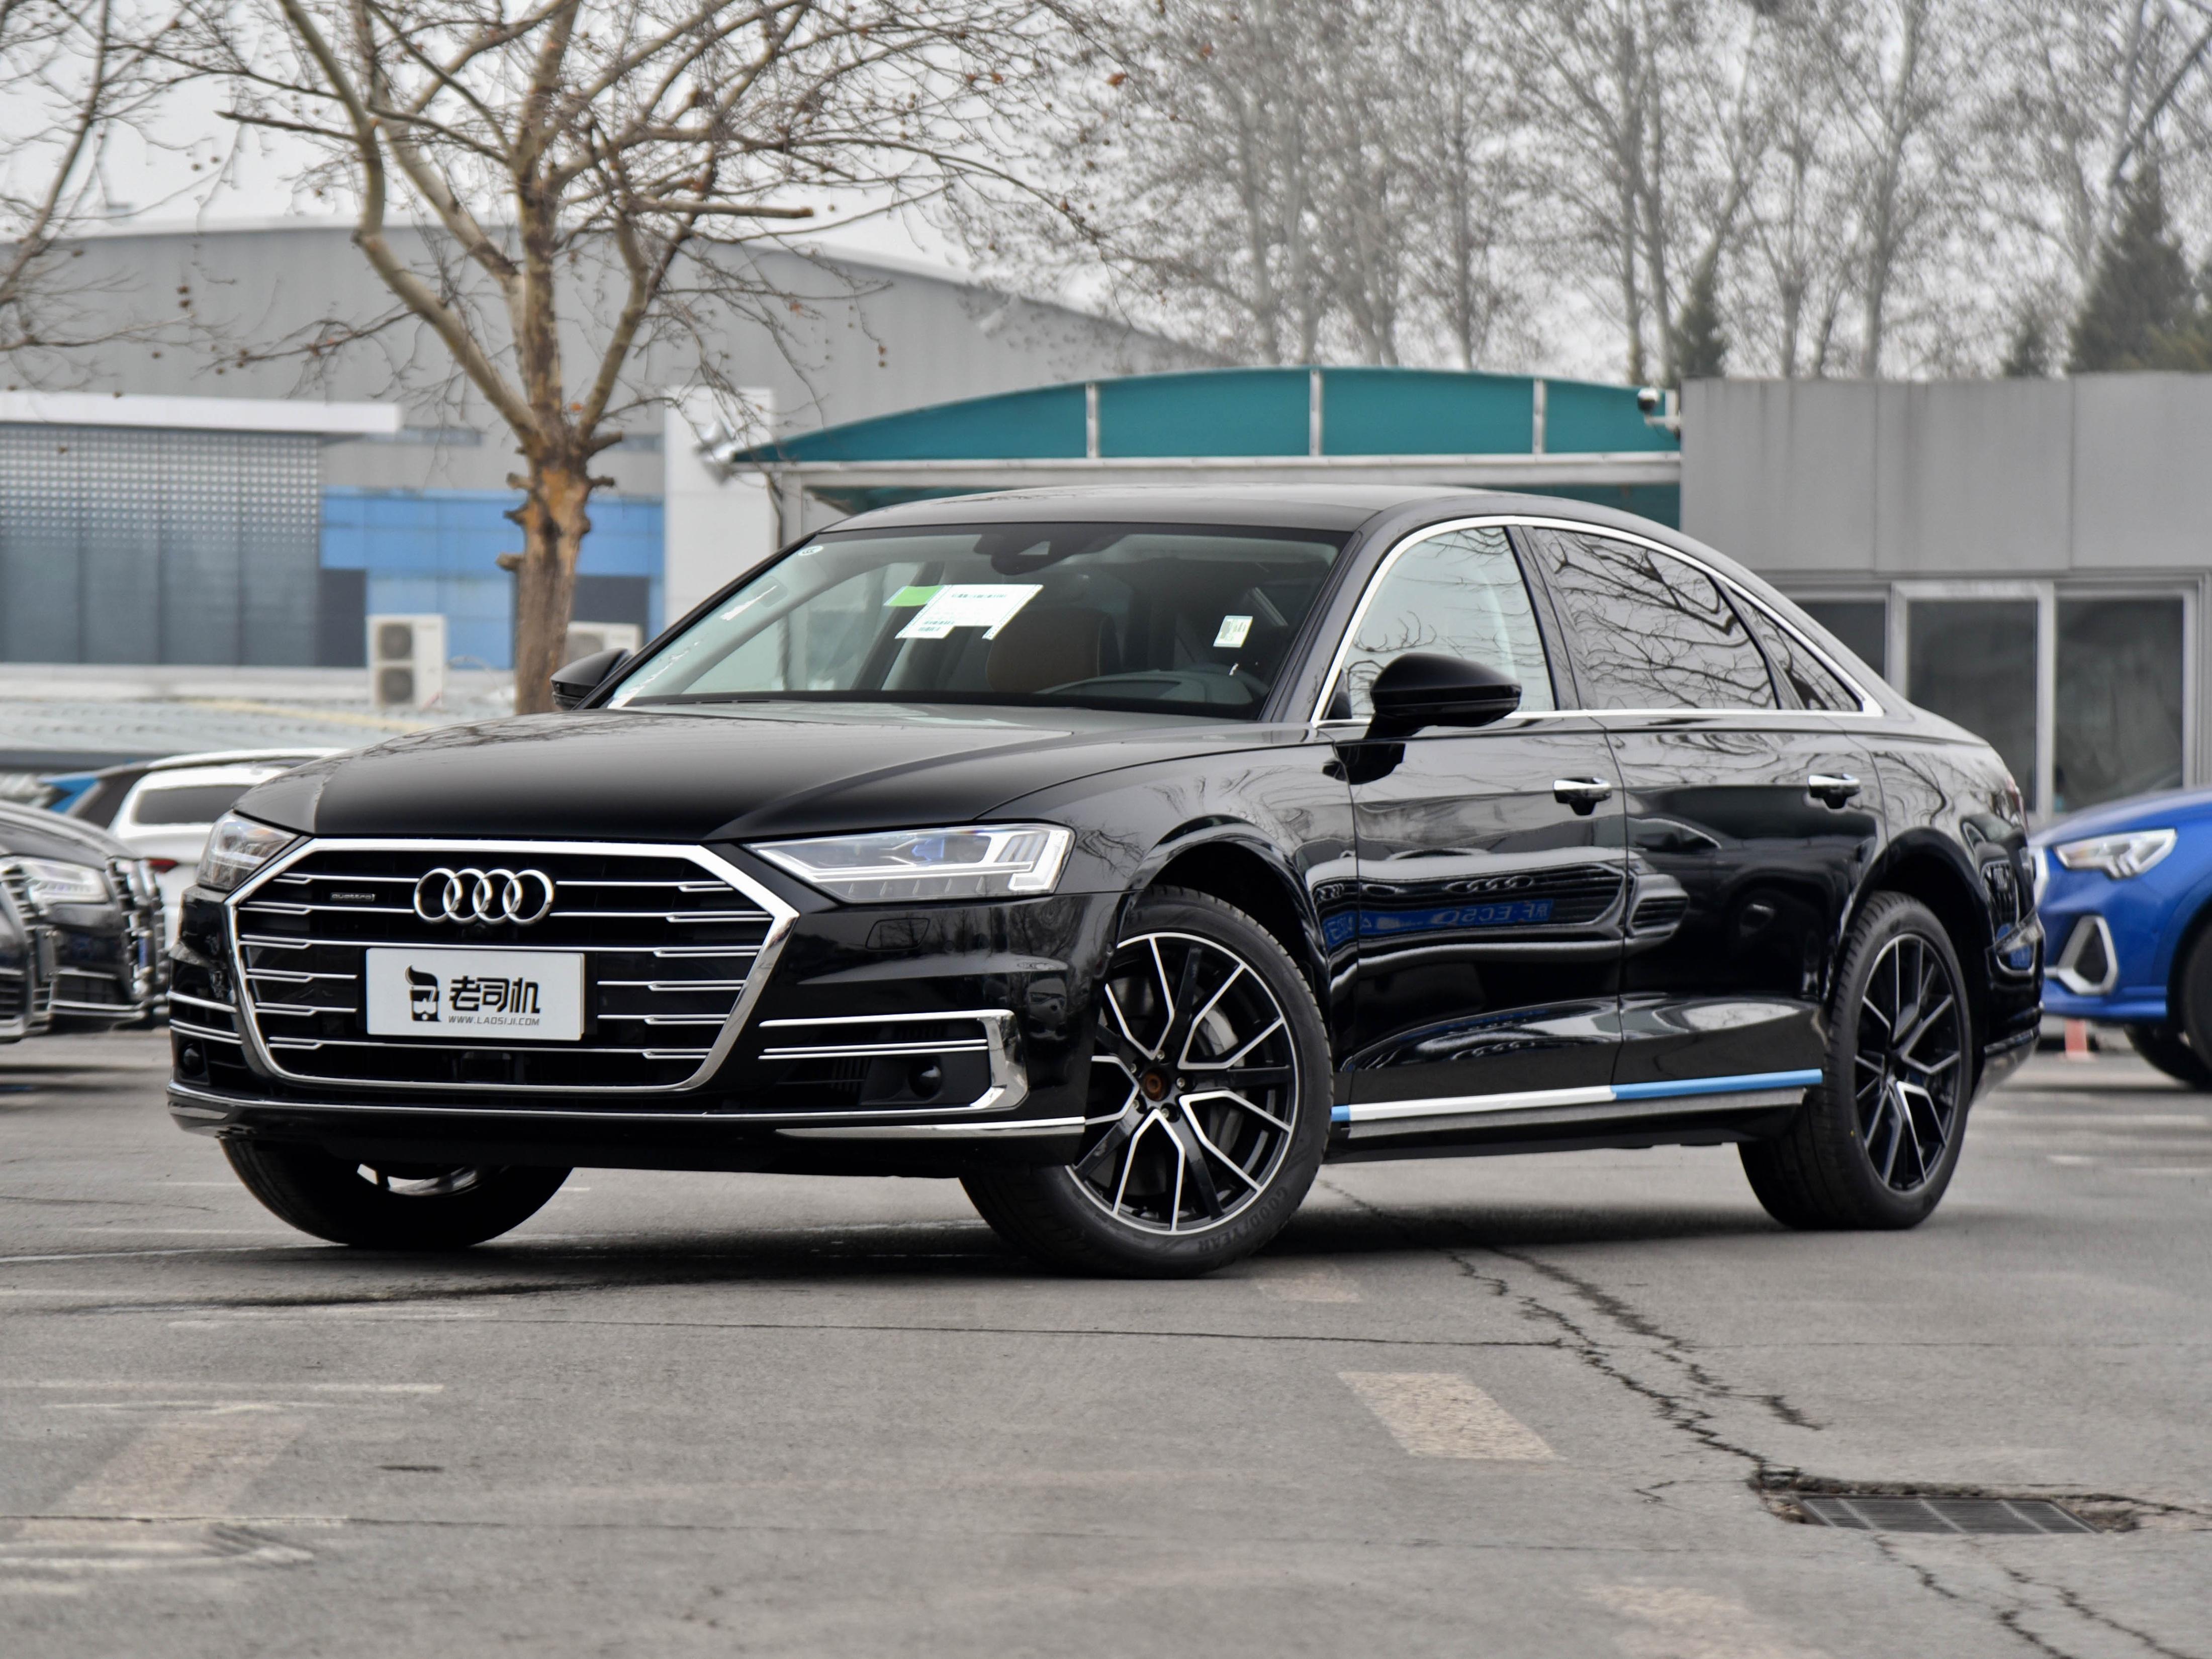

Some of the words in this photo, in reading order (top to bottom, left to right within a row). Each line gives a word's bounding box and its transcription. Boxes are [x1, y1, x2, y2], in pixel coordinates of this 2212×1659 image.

[448, 975, 541, 1014] 老司机
[448, 1015, 540, 1027] WWW.LAOSIJI.COM
